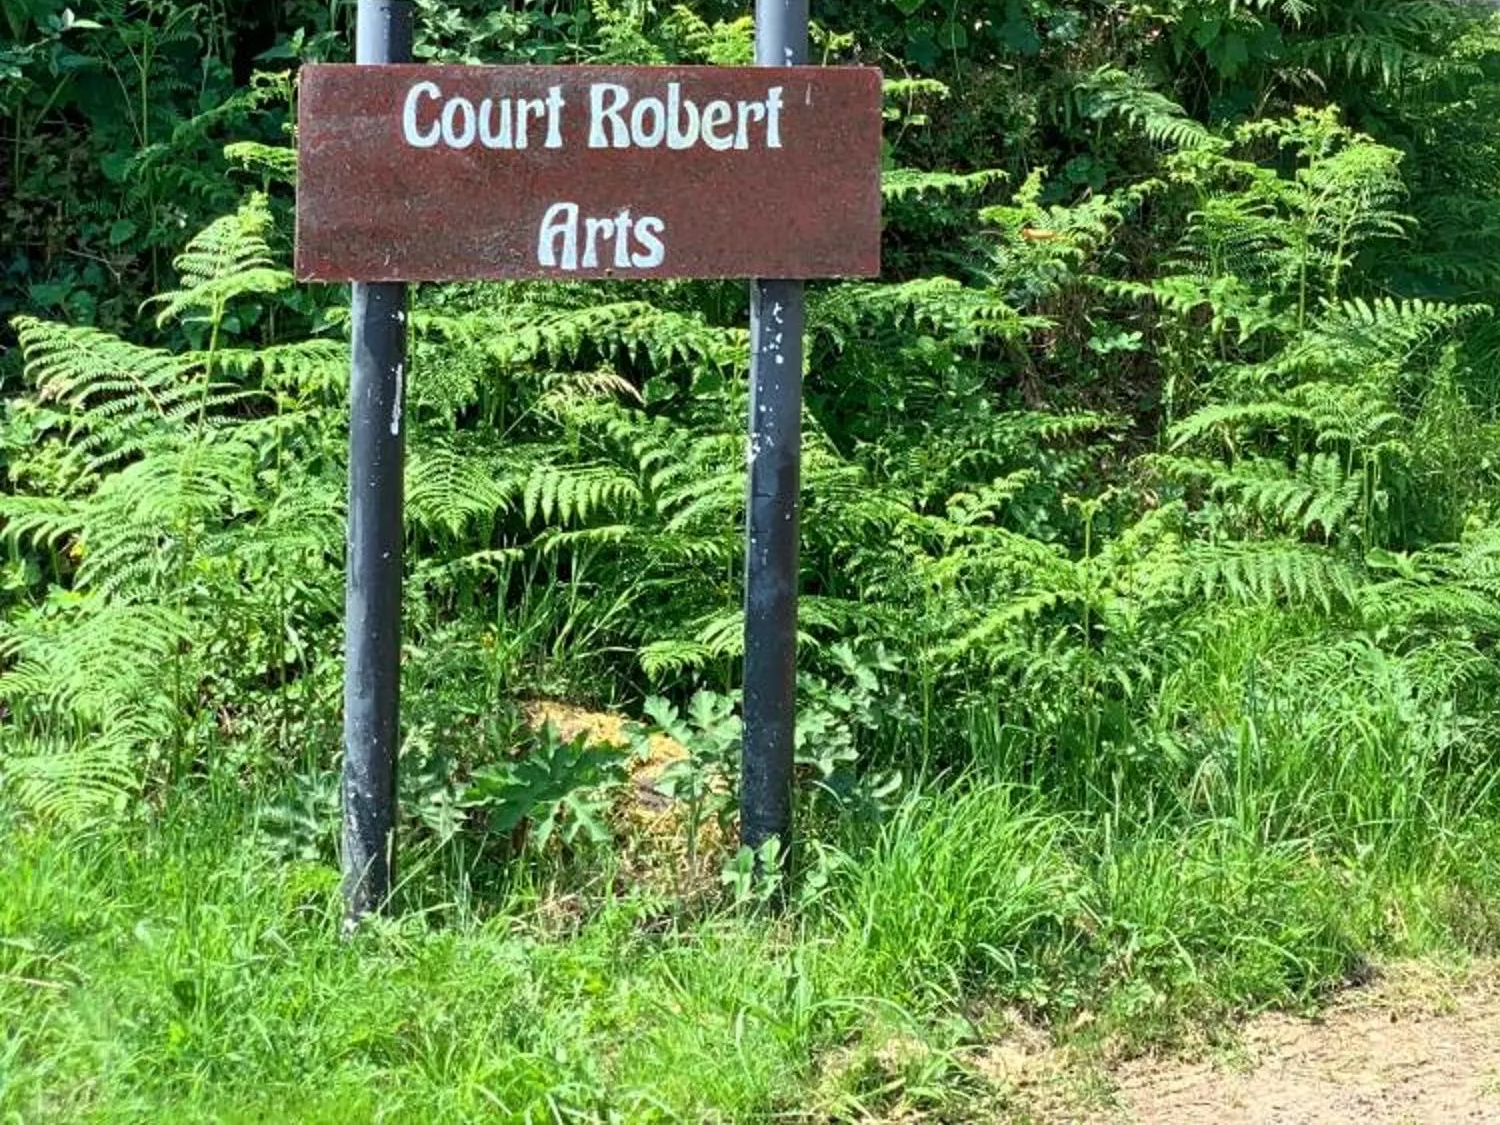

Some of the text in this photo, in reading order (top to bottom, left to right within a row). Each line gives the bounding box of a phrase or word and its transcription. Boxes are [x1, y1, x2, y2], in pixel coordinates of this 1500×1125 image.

[402, 80, 784, 151] Court Robert
[536, 201, 666, 271] Arts
